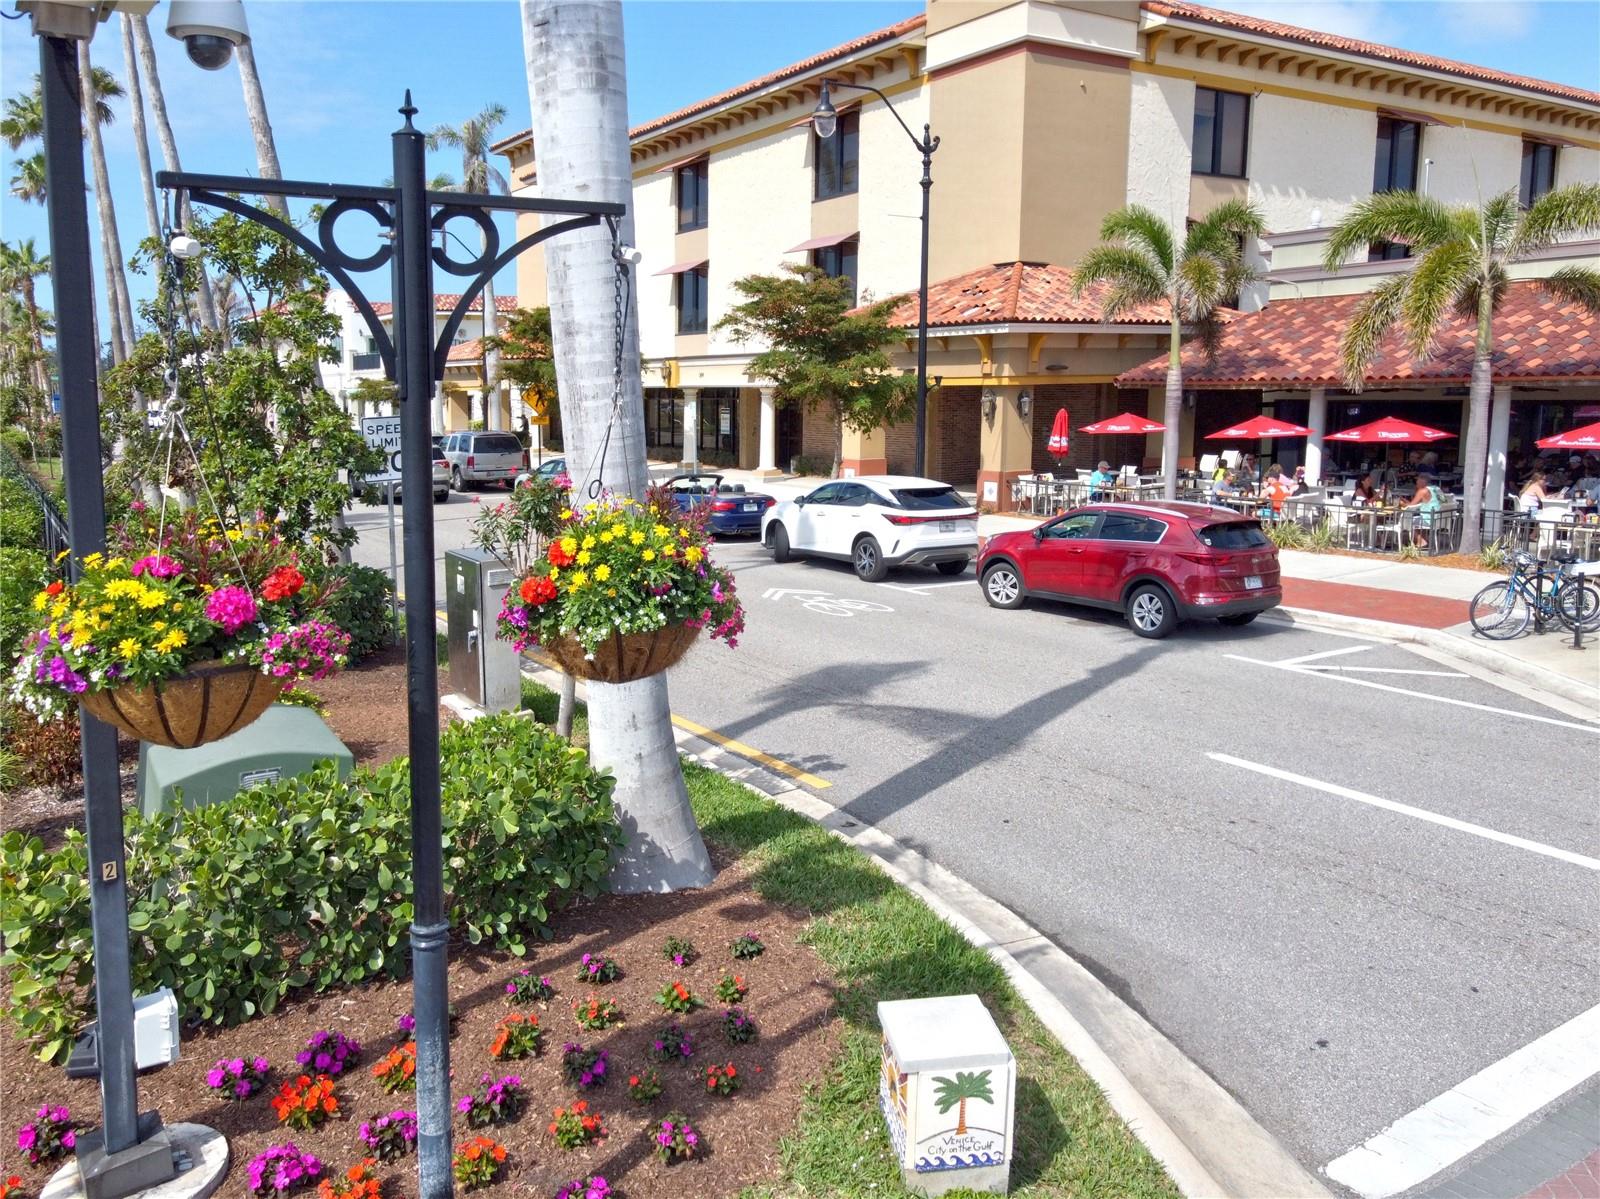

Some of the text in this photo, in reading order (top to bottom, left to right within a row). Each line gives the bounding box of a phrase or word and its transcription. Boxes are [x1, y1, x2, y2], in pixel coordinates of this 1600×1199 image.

[367, 424, 401, 435] SPEE
[372, 437, 401, 448] LIMI
[105, 863, 115, 879] 2
[928, 1145, 947, 1156] City
[958, 1144, 972, 1153] the
[973, 1141, 995, 1151] Gulf
